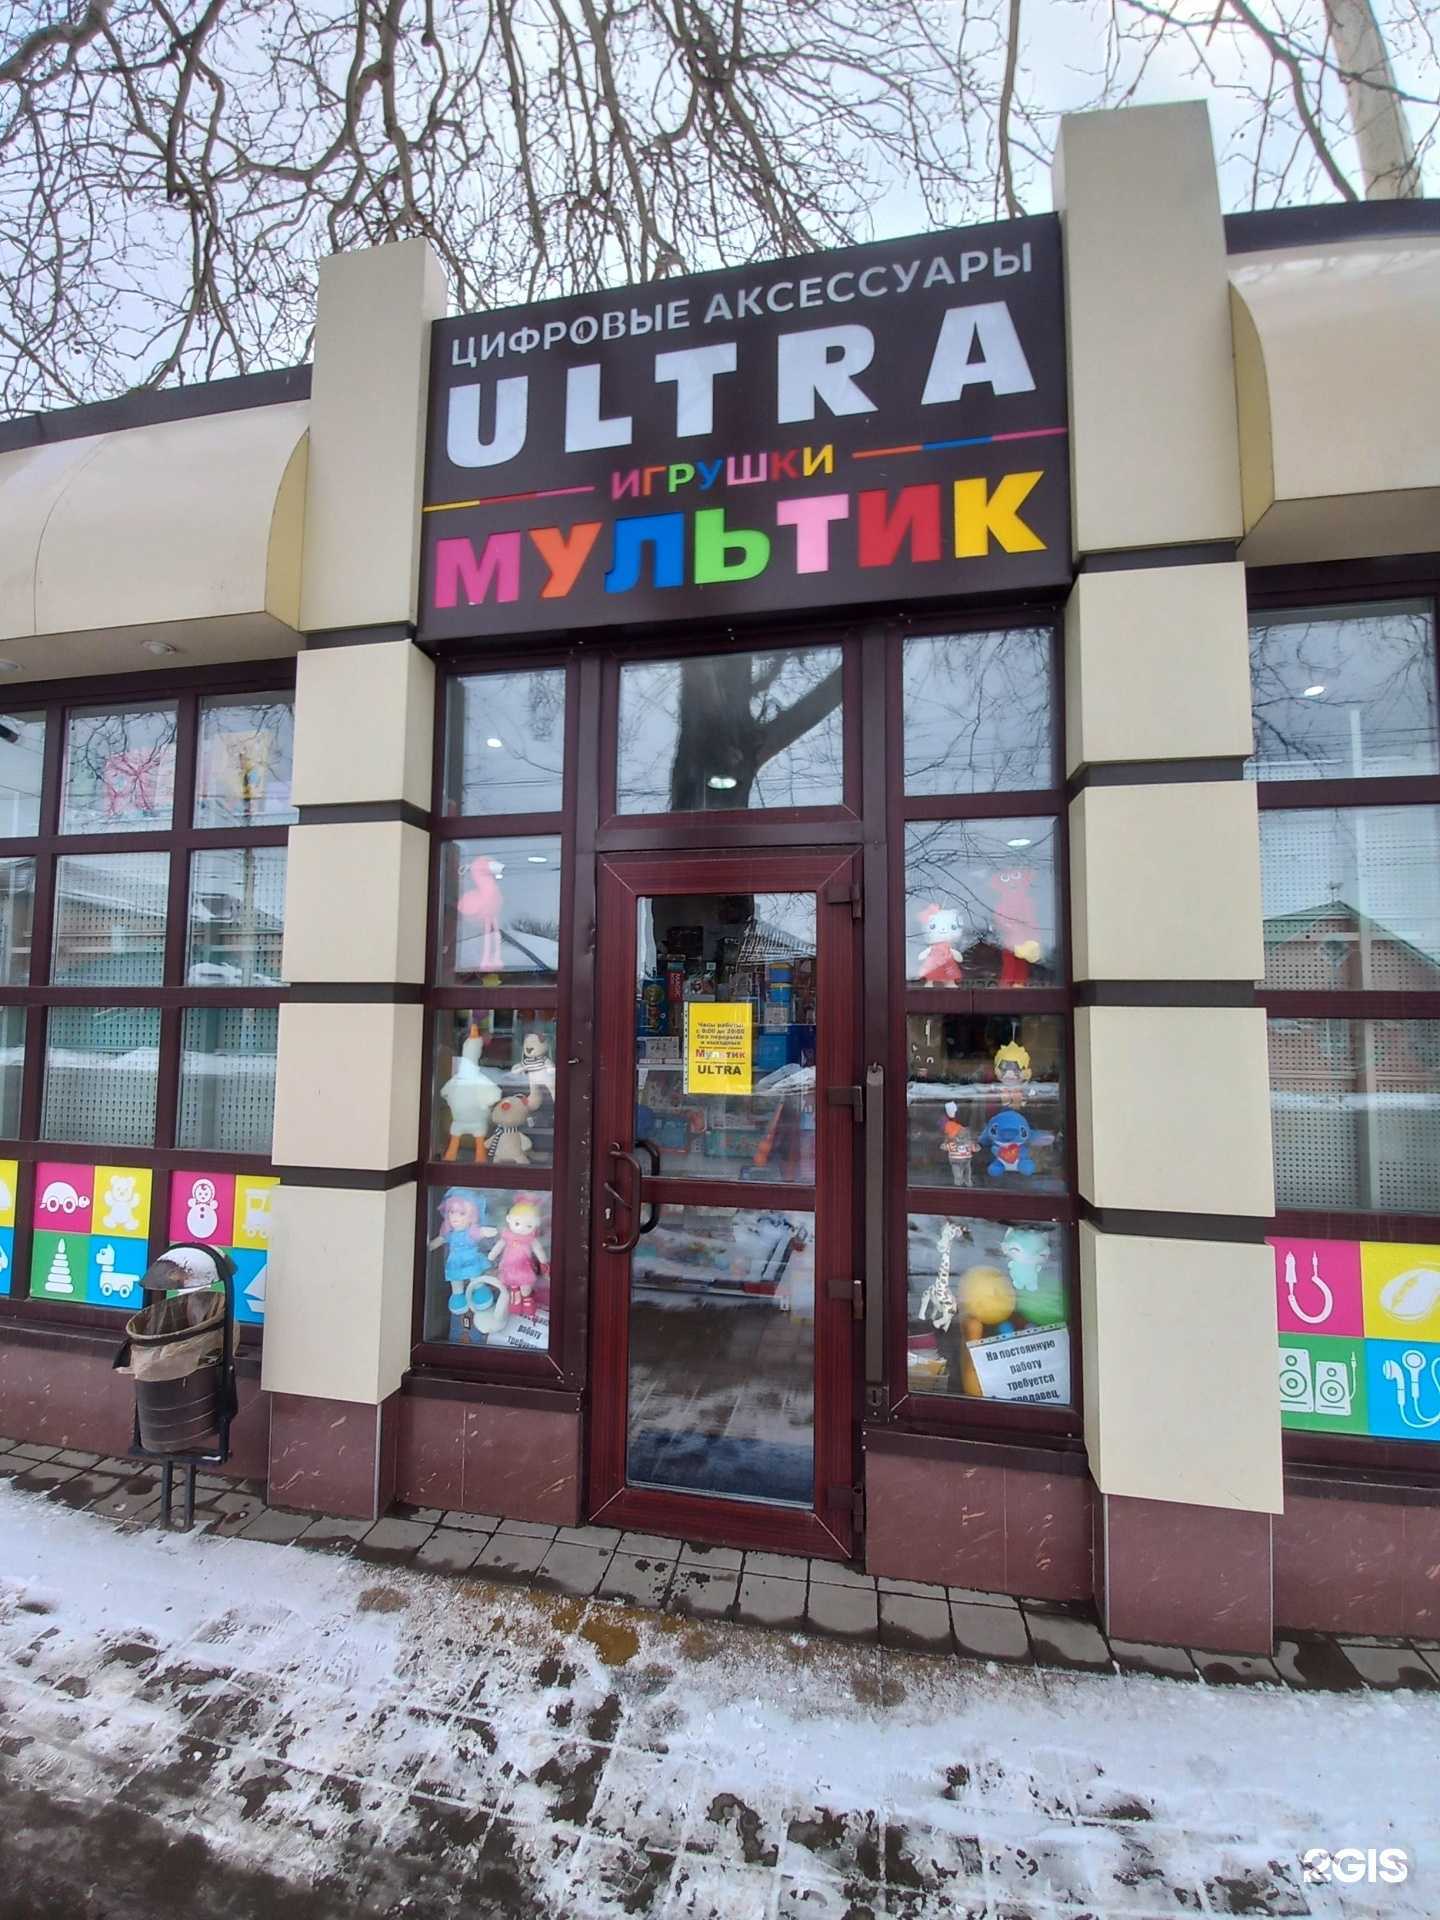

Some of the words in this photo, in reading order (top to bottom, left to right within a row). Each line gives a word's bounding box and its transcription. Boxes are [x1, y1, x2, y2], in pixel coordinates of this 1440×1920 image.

[451, 299, 691, 369] ЦИФРОВЫЕ
[703, 242, 1033, 324] АКСЕССУАРЫ
[446, 300, 1036, 470] ULTRA
[610, 443, 834, 500] ИГРУШКИ
[434, 470, 1047, 610] МУЛЬТИК
[697, 1065, 742, 1075] ULTRA
[985, 1351, 999, 1362] На
[1000, 1339, 1056, 1360] постоянную
[1009, 1359, 1042, 1375] работу
[1007, 1374, 1055, 1392] требуется
